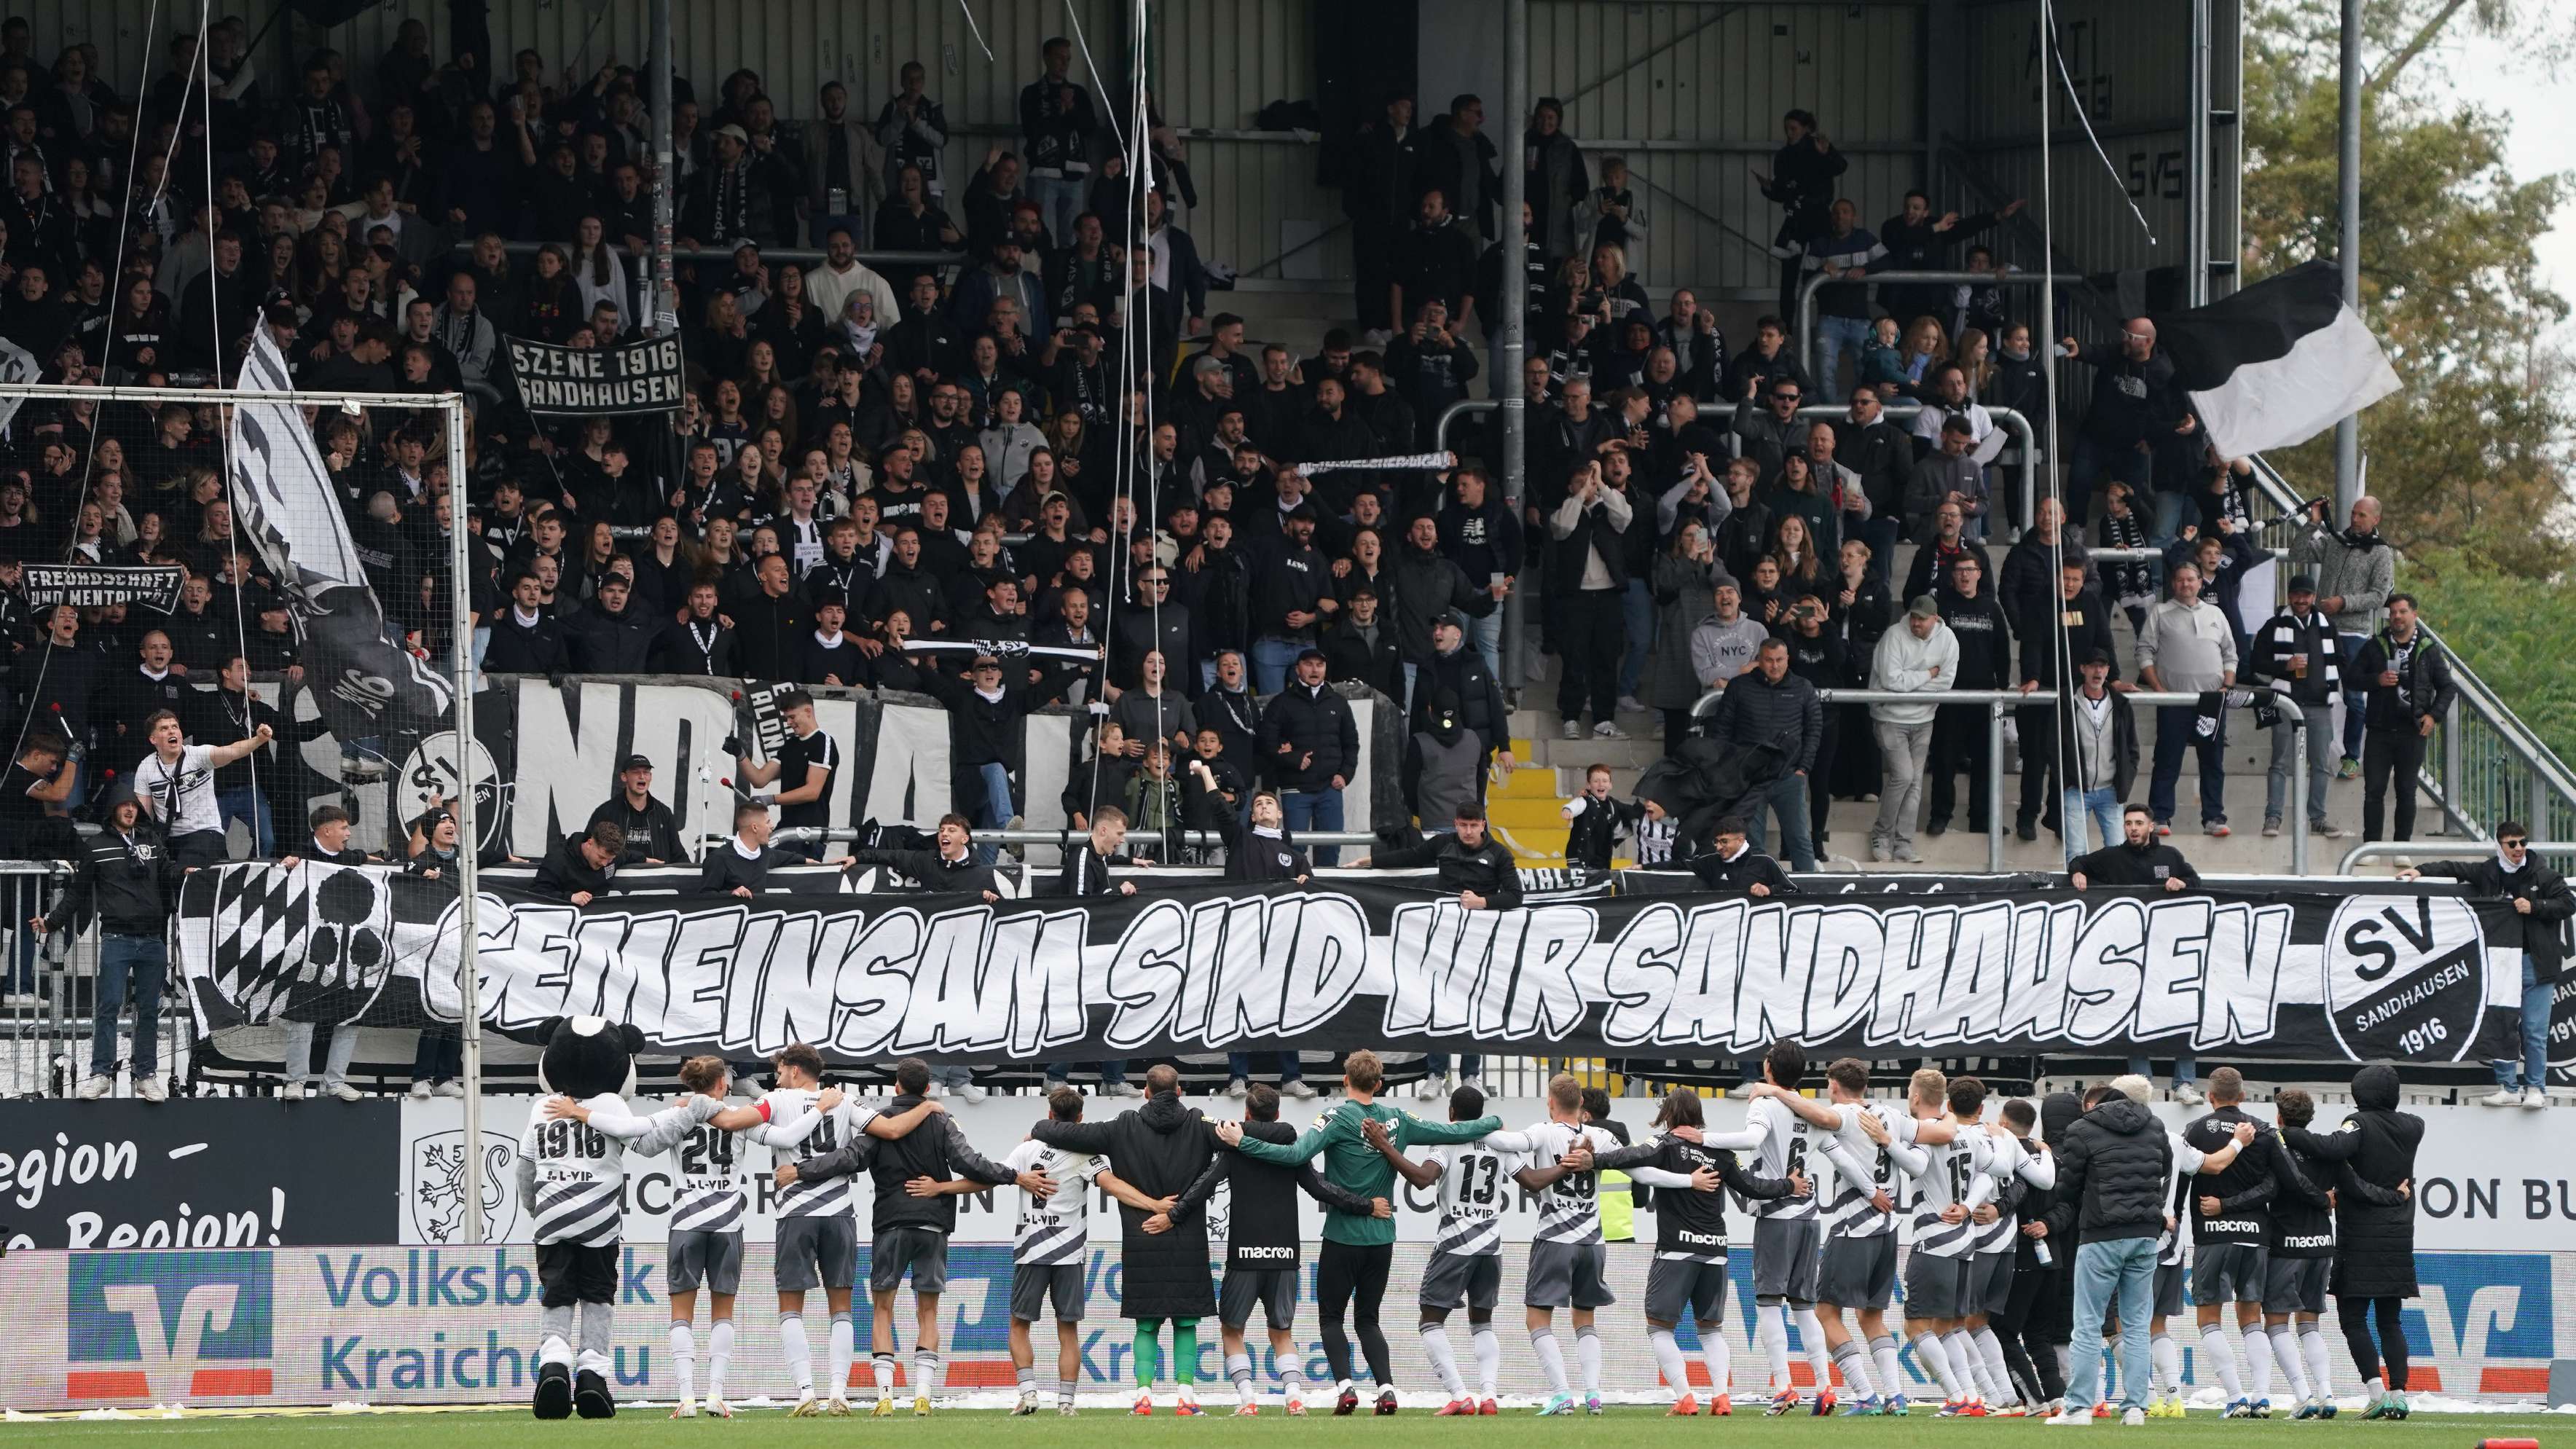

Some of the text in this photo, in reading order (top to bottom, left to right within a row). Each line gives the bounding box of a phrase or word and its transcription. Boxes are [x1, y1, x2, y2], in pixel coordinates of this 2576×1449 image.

[2129, 152, 2183, 199] SVS
[512, 340, 677, 377] SZENE 1916
[519, 374, 681, 407] SANDHAUSEN
[28, 570, 178, 589] FREUNDSCHAFT
[1721, 645, 1746, 656] NYC
[2344, 895, 2434, 981] SV
[420, 892, 2294, 1056] GEMEINSAM SIND WIR SANDHAUSEN
[2356, 959, 2470, 1032] SANDHAUSEN
[2399, 1017, 2448, 1055] 1916
[2550, 1015, 2576, 1044] 191
[534, 1119, 606, 1159] 1916
[681, 1126, 734, 1174] 24
[559, 1171, 593, 1182] L-VIP
[698, 1179, 730, 1190] L-VIP
[1459, 1154, 1498, 1204] 13
[1464, 1208, 1493, 1220] L-VIP
[2412, 1178, 2500, 1219] ON
[2205, 1220, 2260, 1233] macron
[2285, 1234, 2332, 1248] macron
[1238, 1246, 1294, 1259] macron
[316, 1247, 655, 1308] Volksbk
[321, 1330, 649, 1391] Kraichu
